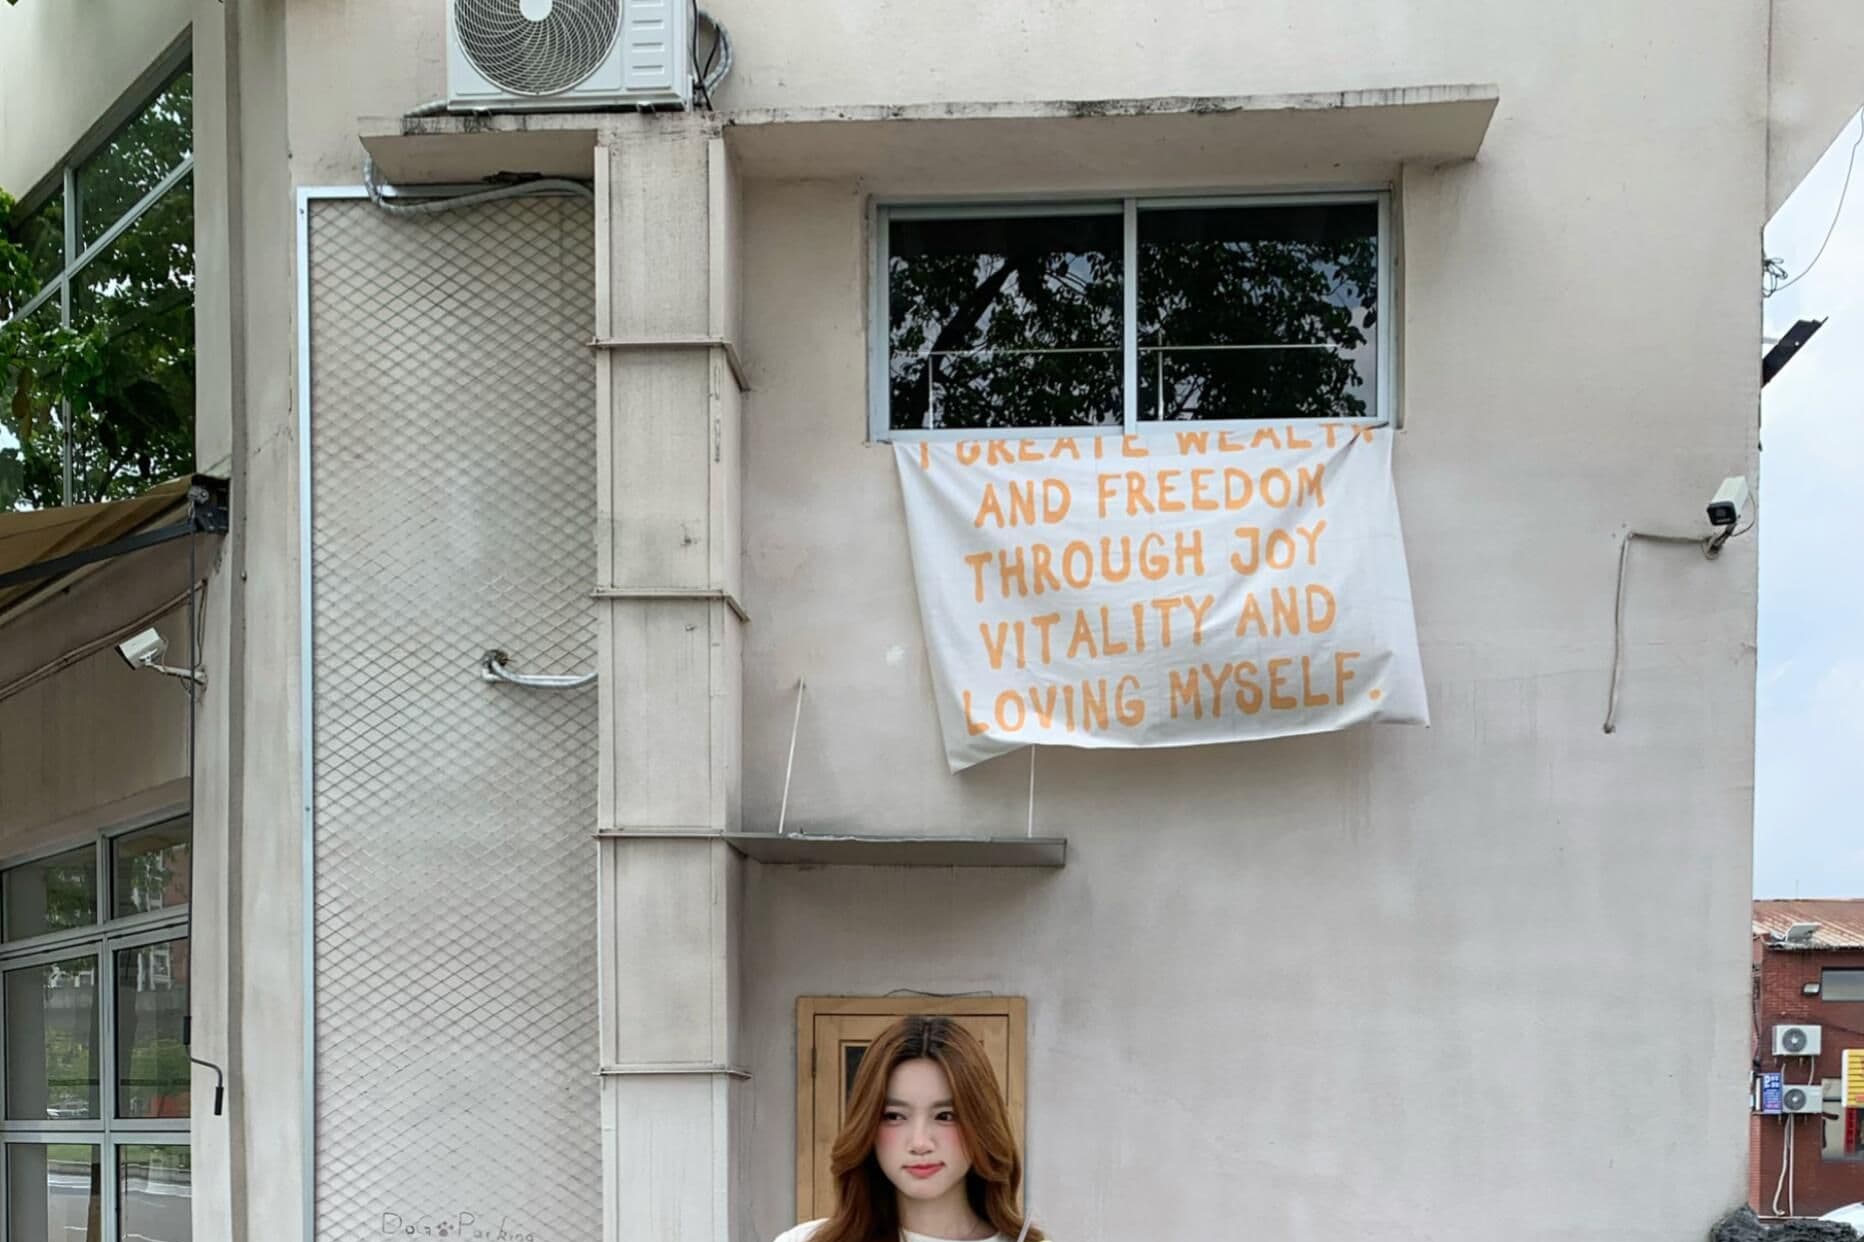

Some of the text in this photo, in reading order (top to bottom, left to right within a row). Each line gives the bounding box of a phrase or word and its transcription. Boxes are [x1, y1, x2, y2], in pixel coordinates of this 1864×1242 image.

[974, 463, 1326, 529] AND FREEDOM
[964, 519, 1326, 602] THROUGH JOY
[979, 583, 1338, 670] VITALITY AND
[962, 651, 1383, 737] LOVING MYSELF.
